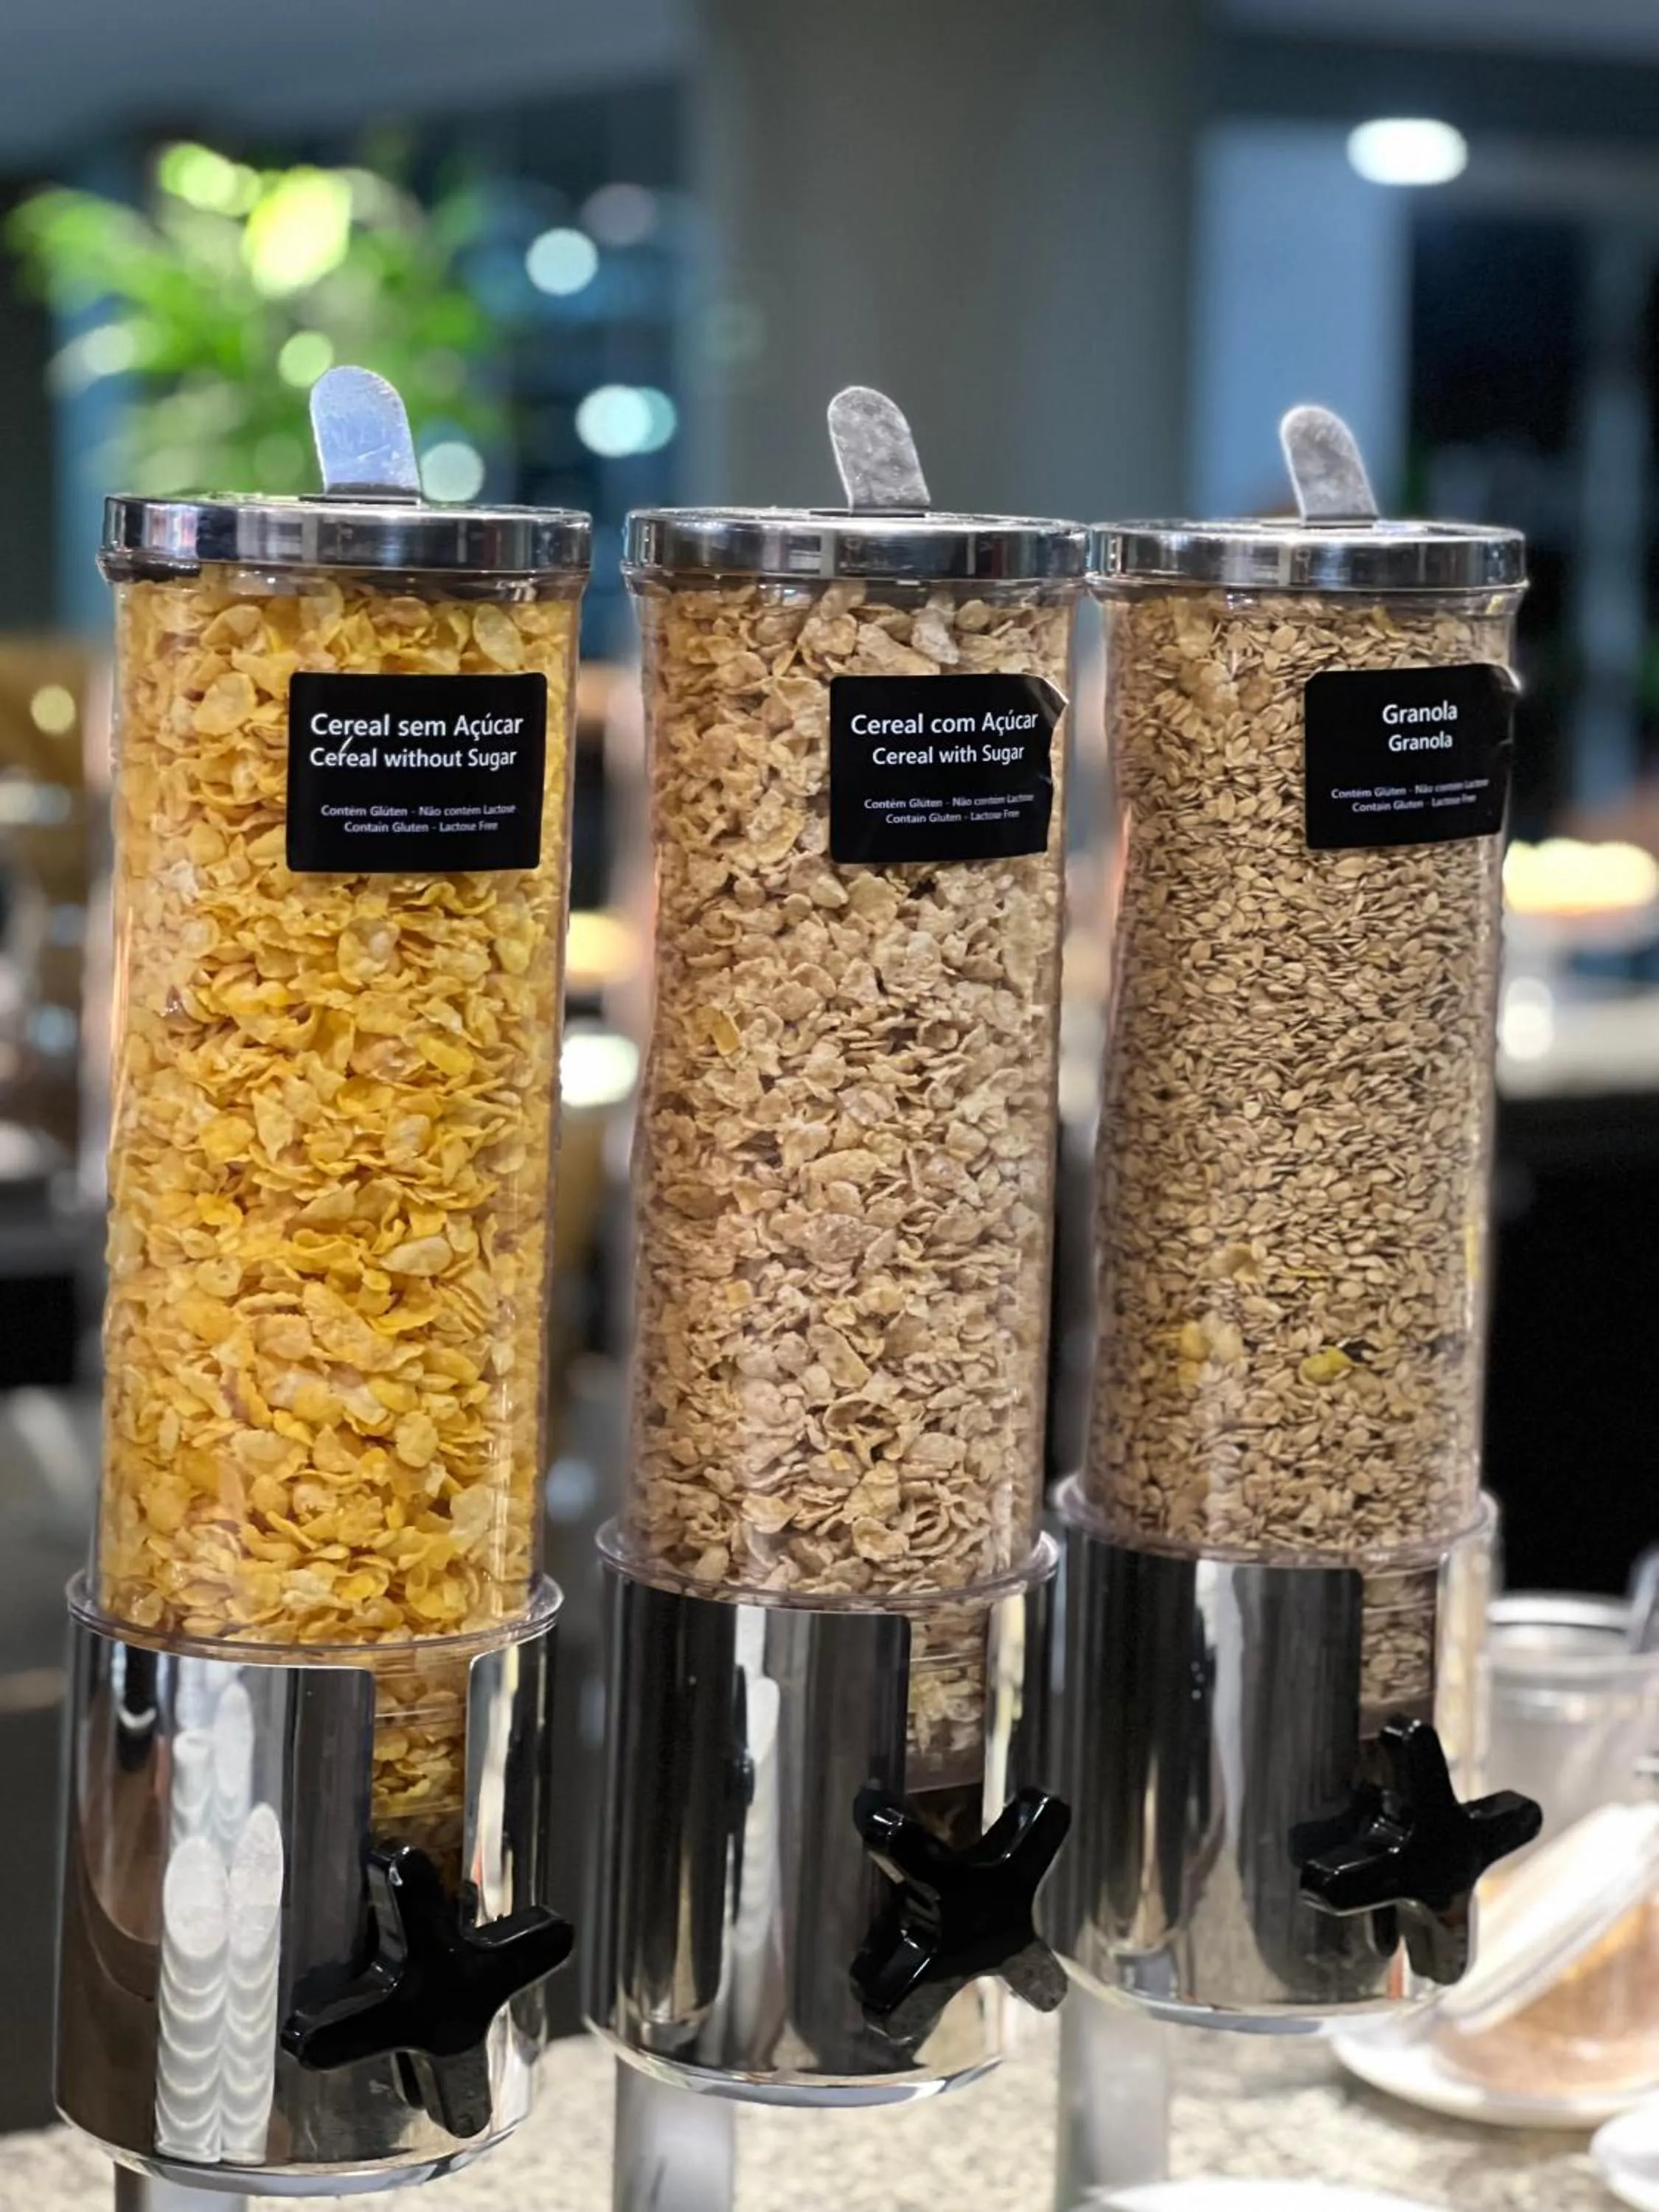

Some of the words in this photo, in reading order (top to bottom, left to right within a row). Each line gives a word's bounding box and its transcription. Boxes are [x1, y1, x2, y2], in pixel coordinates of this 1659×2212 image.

[1382, 700, 1458, 724] Granola
[311, 713, 389, 736] Cereal
[397, 719, 446, 736] sem
[454, 713, 524, 740] Açúcar
[852, 713, 923, 734] Cereal
[931, 717, 975, 733] com
[981, 710, 1038, 736] Açúcar
[1388, 731, 1453, 751] Granola
[310, 748, 377, 767] Cereal
[384, 748, 462, 767] without
[468, 748, 517, 771] Sugar
[873, 746, 933, 765] Cereal
[939, 745, 977, 763] with
[982, 744, 1024, 765] Sugar
[419, 805, 442, 816] Não
[1352, 801, 1392, 813] Contain
[344, 821, 389, 832] Contain
[392, 821, 429, 832] Gluten
[439, 822, 478, 832] Lactose
[886, 813, 927, 824] Contain
[928, 812, 961, 823] Gluten
